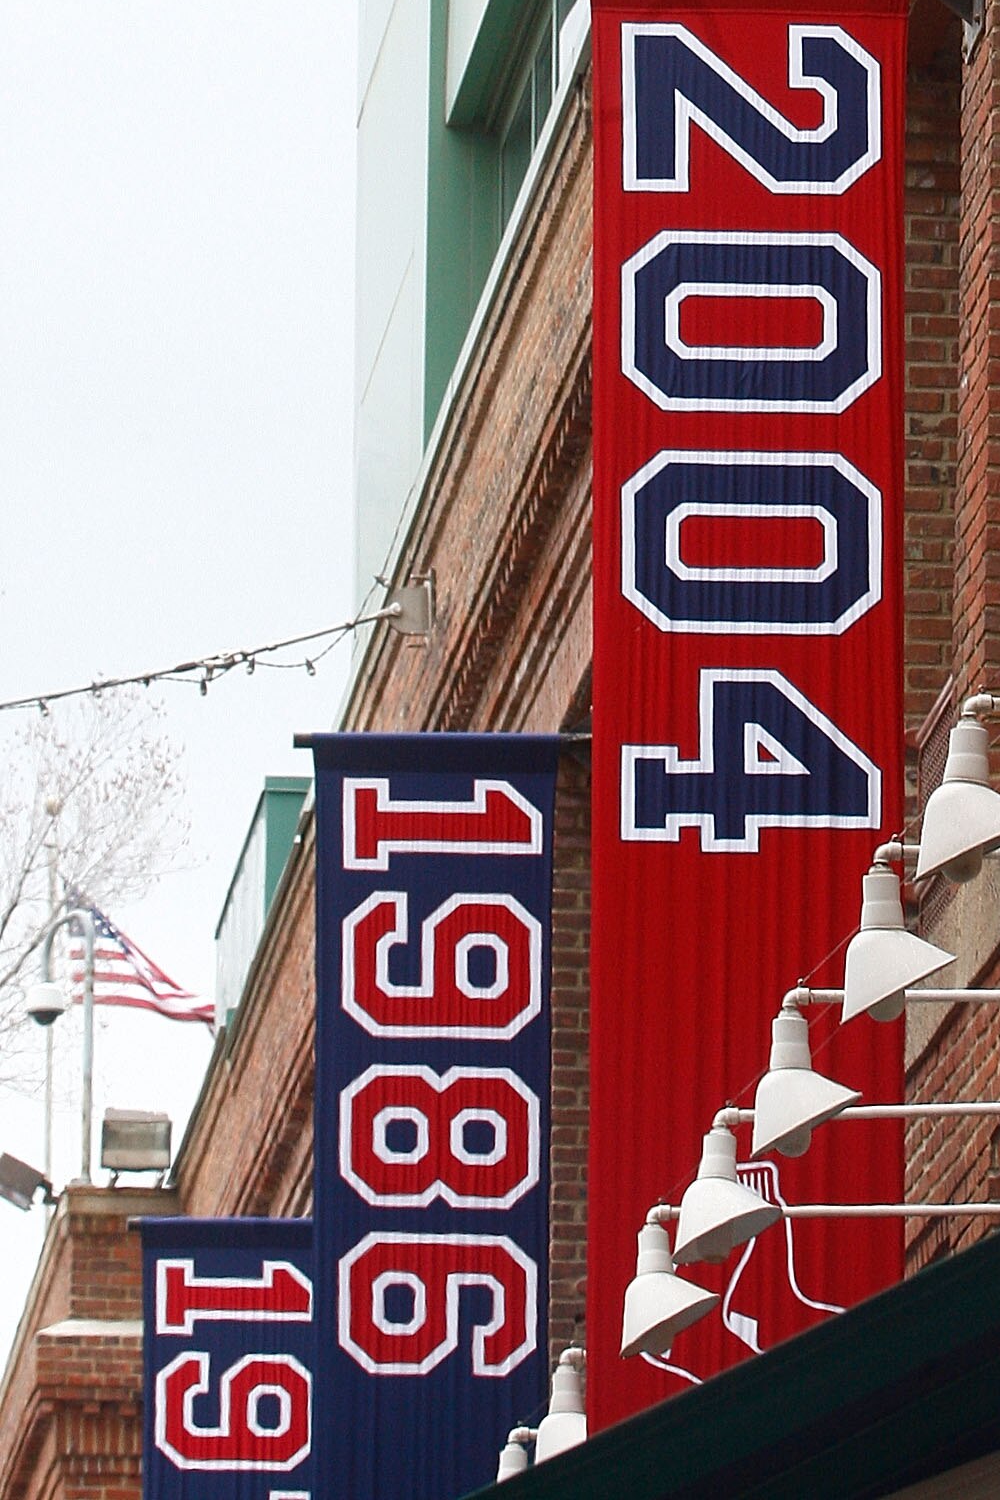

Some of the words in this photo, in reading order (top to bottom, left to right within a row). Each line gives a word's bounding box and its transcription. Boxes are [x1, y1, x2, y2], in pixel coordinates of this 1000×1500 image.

[620, 22, 883, 853] 2004
[338, 776, 544, 1377] 1986
[155, 1258, 313, 1500] 19
